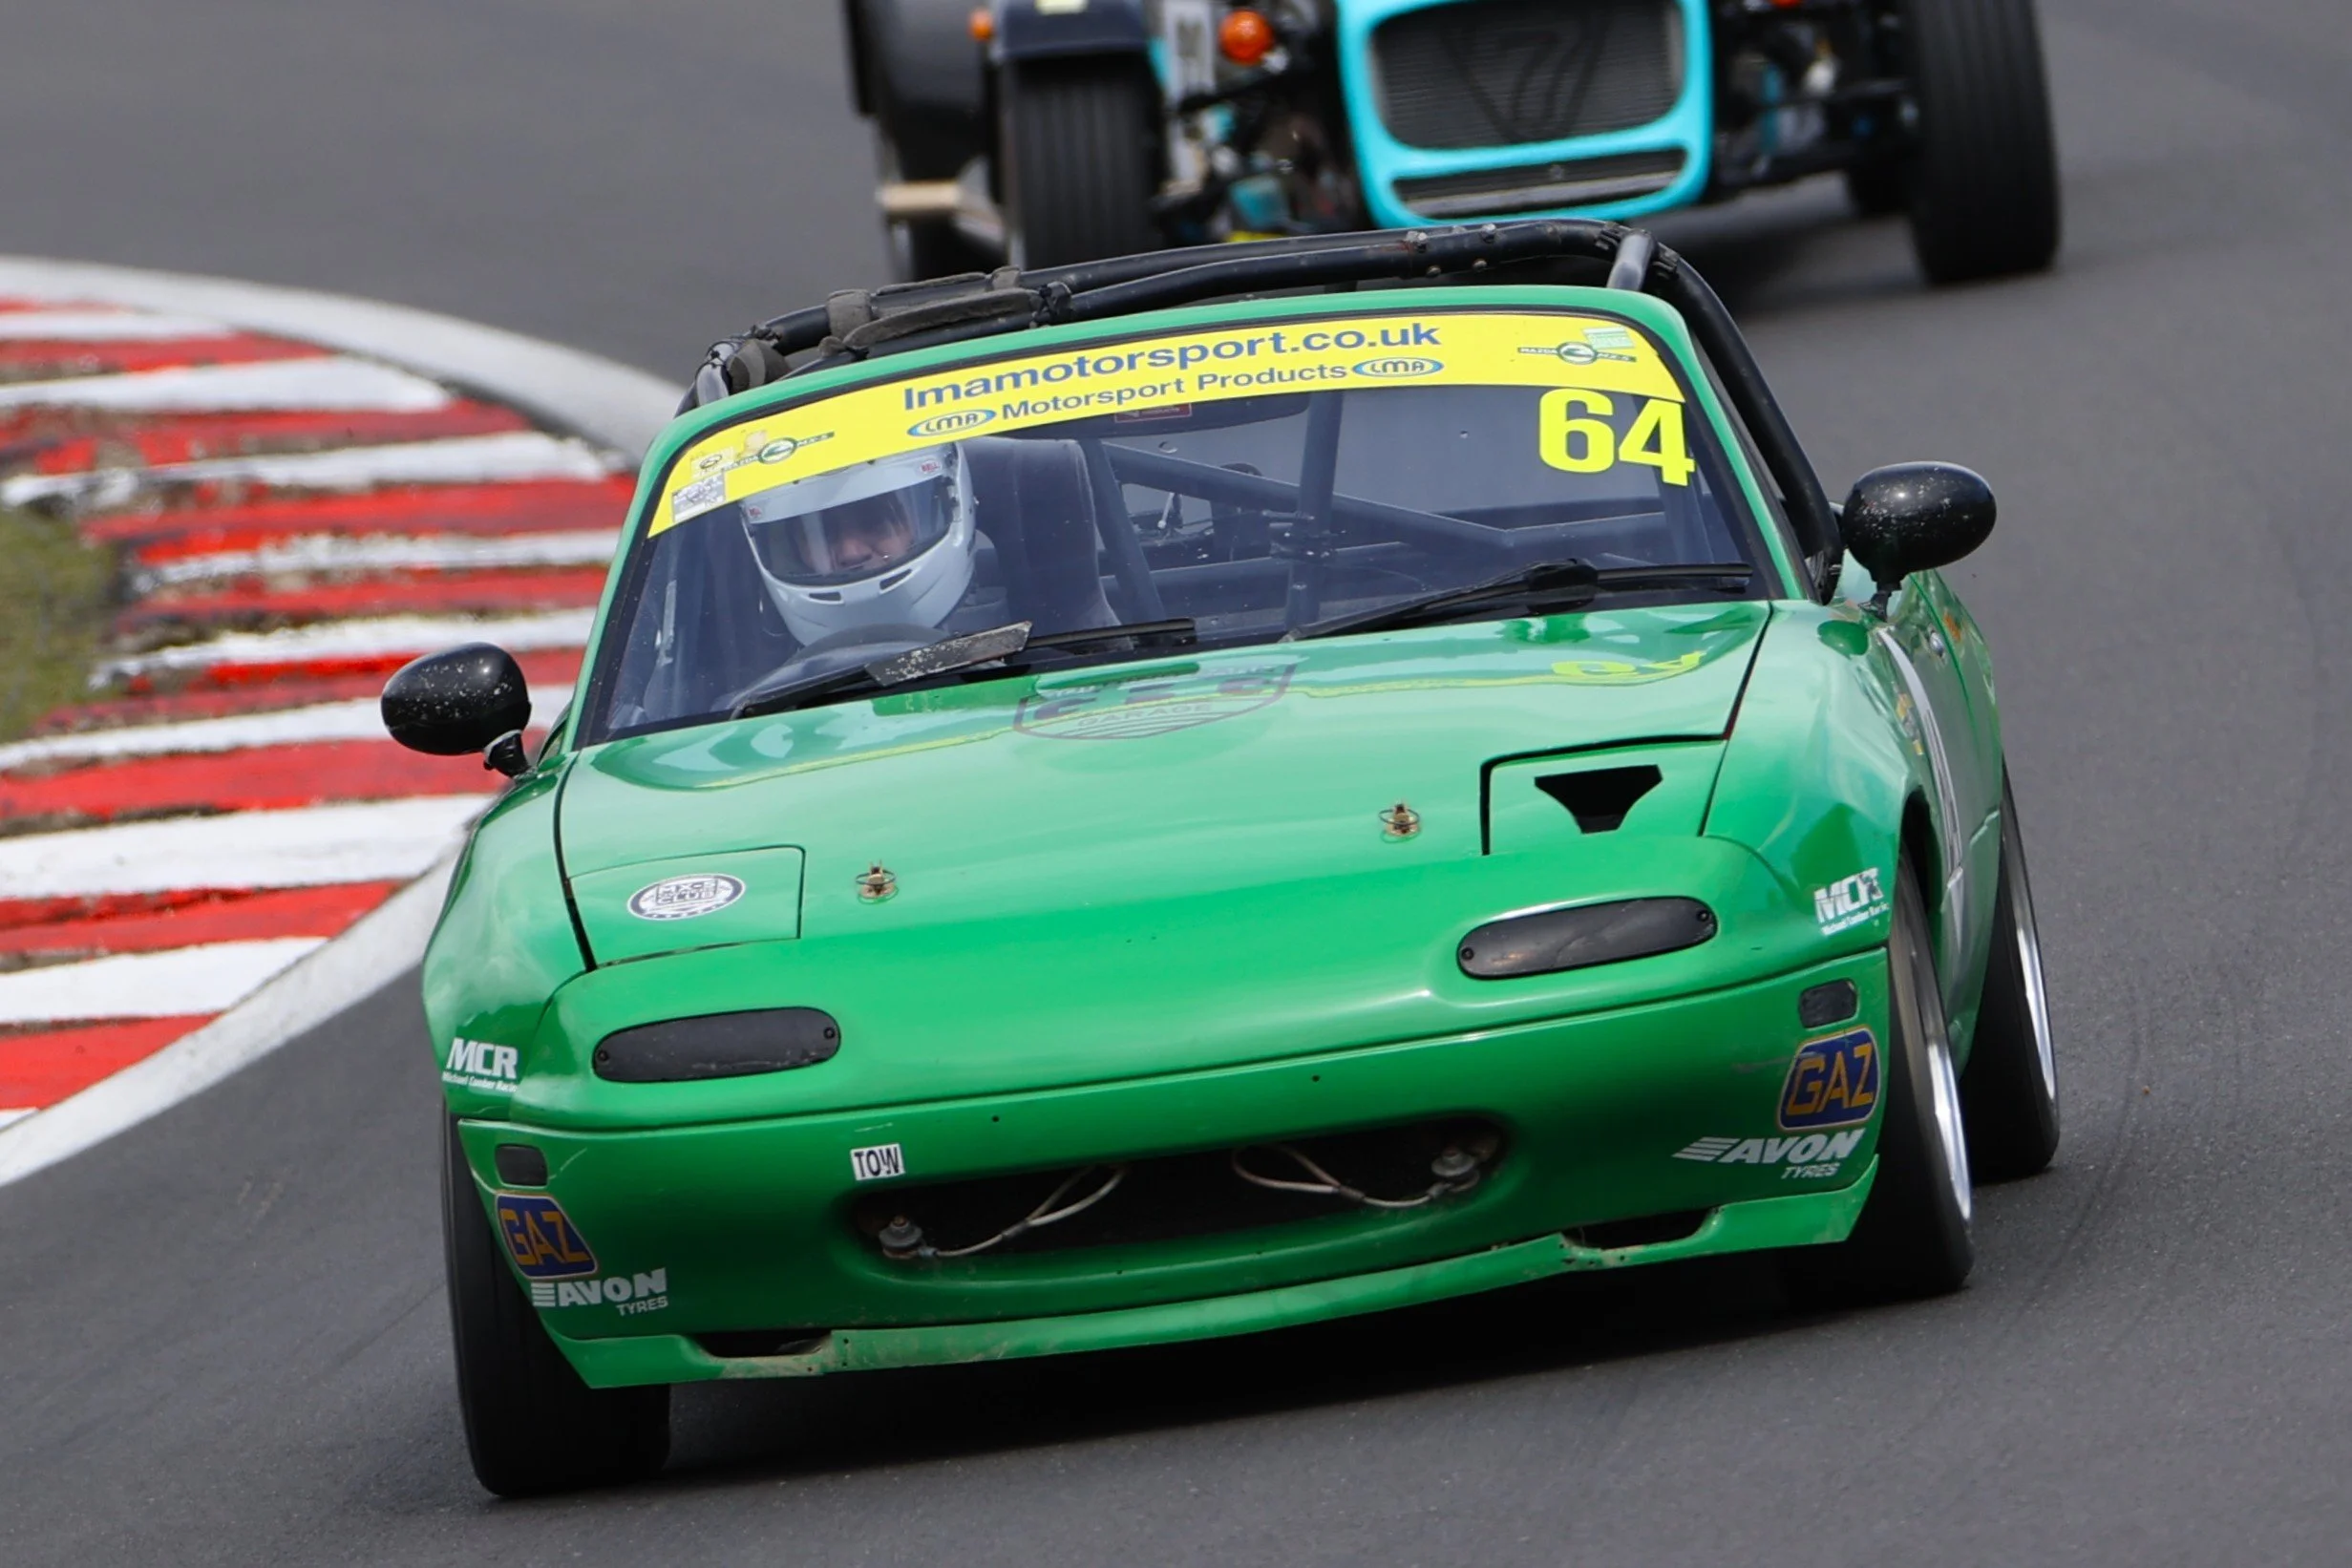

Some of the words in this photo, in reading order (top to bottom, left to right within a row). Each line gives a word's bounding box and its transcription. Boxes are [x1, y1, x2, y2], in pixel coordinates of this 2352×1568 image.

[1003, 378, 1184, 419] Motorsport
[1198, 365, 1346, 391] Products
[1538, 388, 1695, 487] 64
[1814, 867, 1883, 923] MCR
[446, 1037, 519, 1079] MCR
[1786, 1043, 1874, 1116] GAZ
[854, 1147, 900, 1176] TOW
[1718, 1128, 1866, 1163] AVON
[1781, 1163, 1840, 1179] TYRES
[498, 1208, 593, 1266] GAZ
[558, 1267, 667, 1306] AVON
[616, 1295, 667, 1316] TYRES
